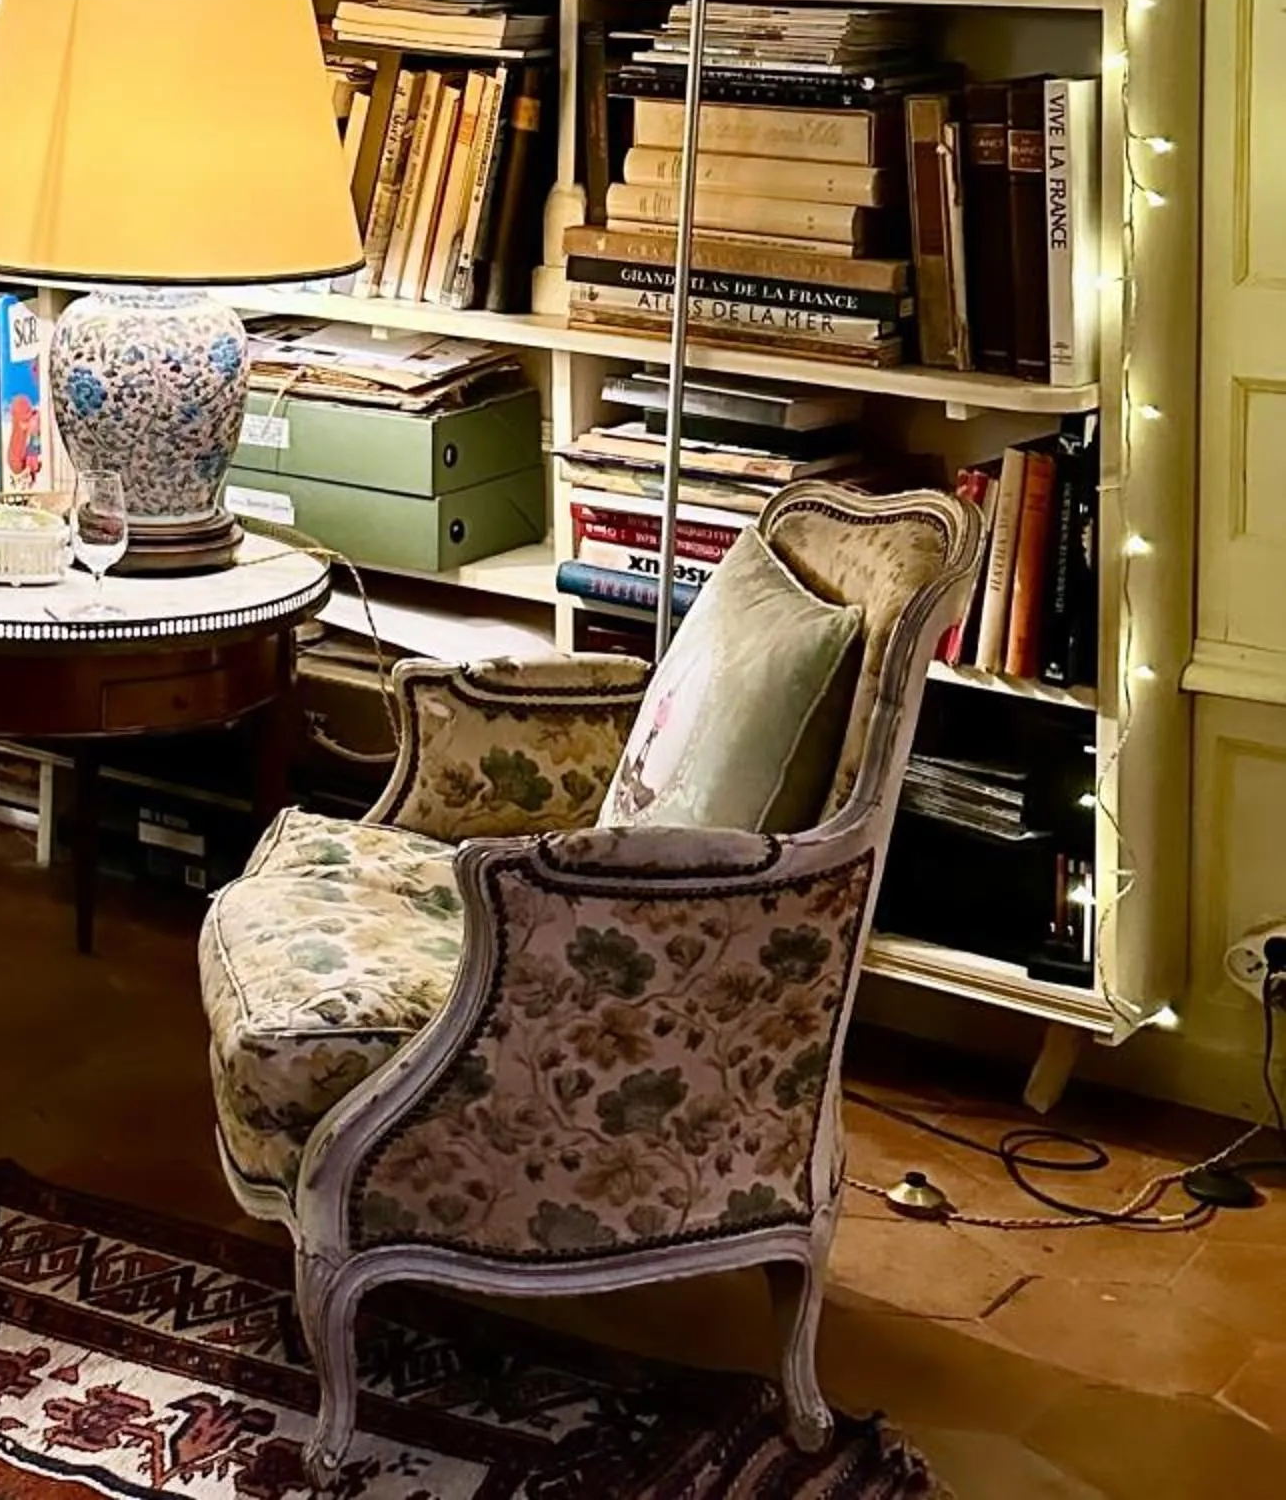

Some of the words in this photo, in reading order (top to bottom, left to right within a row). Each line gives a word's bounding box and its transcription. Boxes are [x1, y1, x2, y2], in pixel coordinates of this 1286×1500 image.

[1049, 94, 1065, 137] VIVE
[1049, 145, 1066, 169] LA
[1049, 178, 1067, 250] FRANCE
[620, 266, 676, 288] GRAND
[687, 274, 730, 294] TLAS
[734, 280, 759, 298] DE
[762, 284, 785, 302] LA
[788, 288, 860, 311] FRANCE
[712, 301, 740, 322] DE
[748, 306, 776, 326] LA
[784, 309, 836, 335] MER
